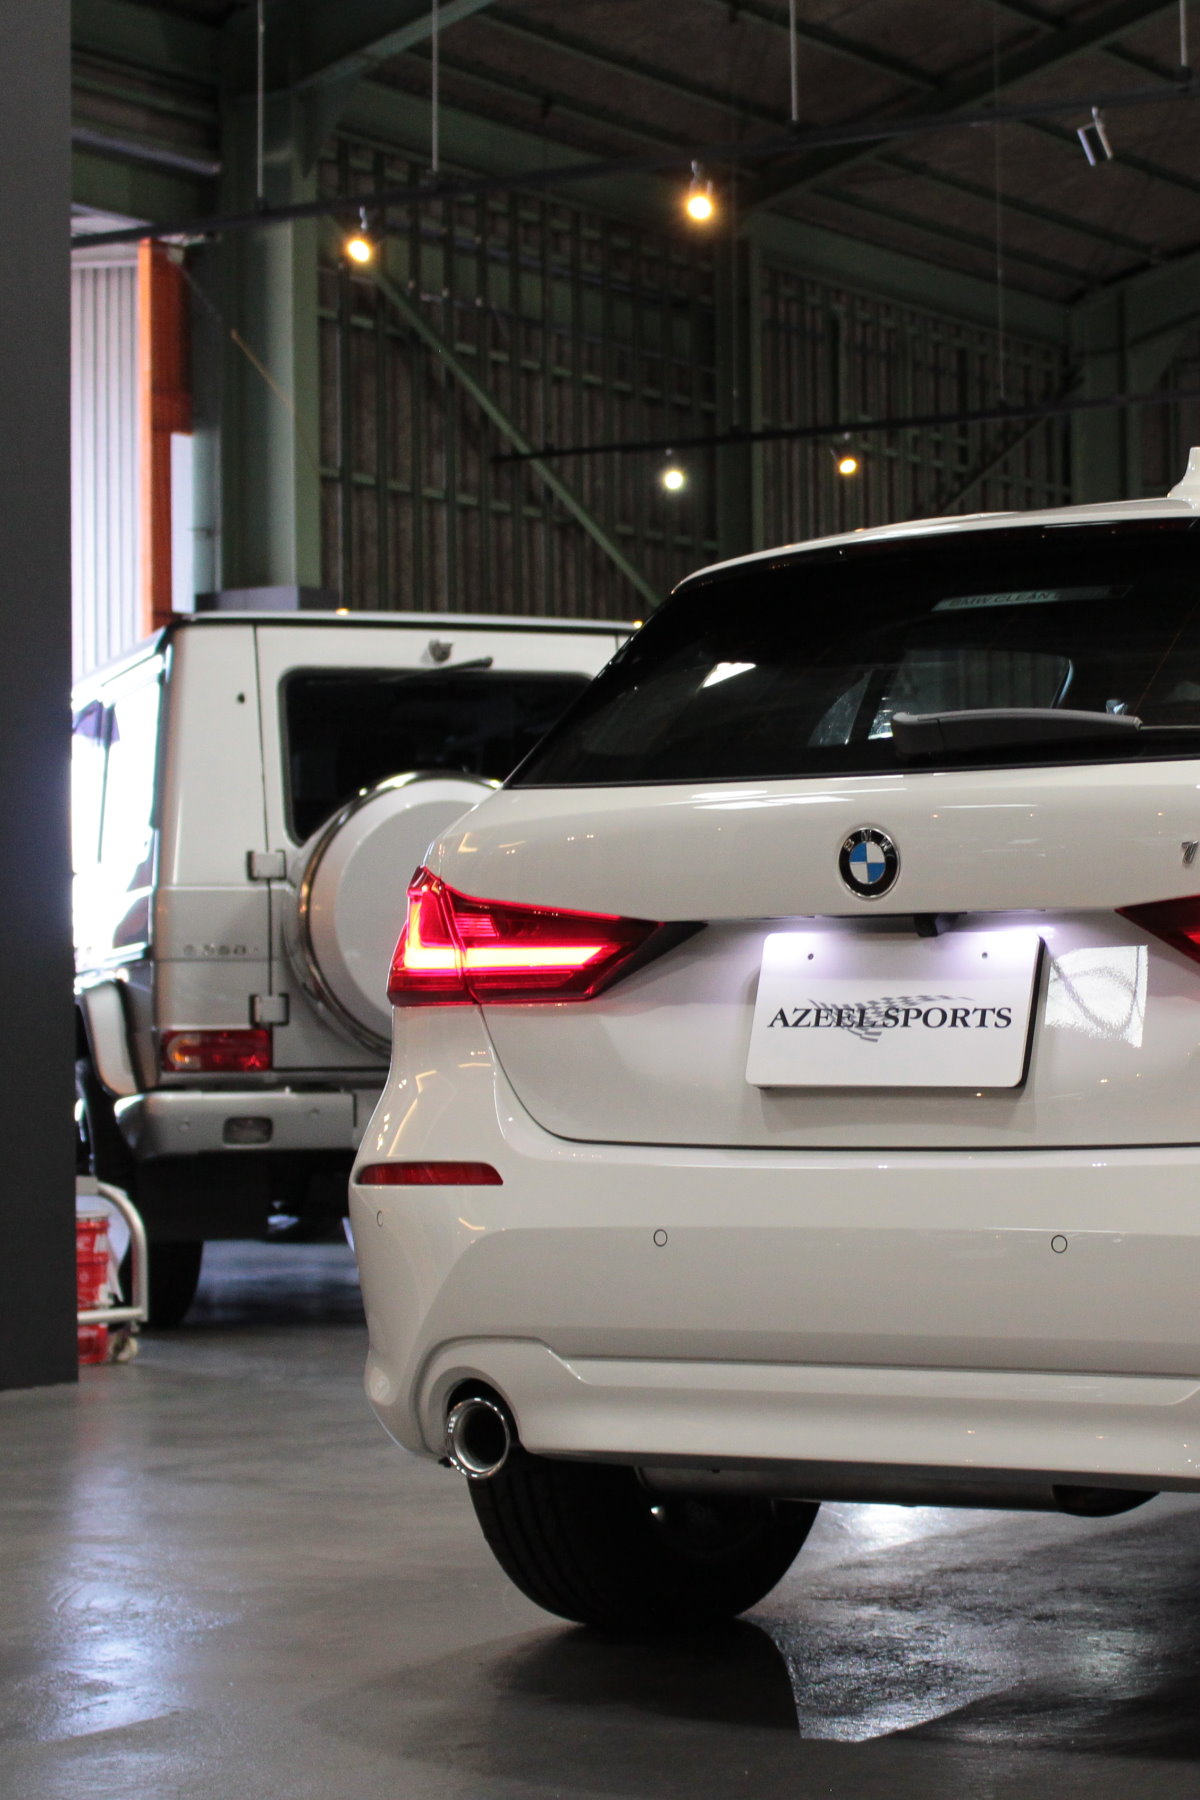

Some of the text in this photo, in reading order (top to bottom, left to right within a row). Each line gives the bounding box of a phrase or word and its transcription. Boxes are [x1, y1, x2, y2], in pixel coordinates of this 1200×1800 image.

[843, 828, 892, 852] BMW
[767, 1006, 1012, 1028] AZEEL SPORTS
